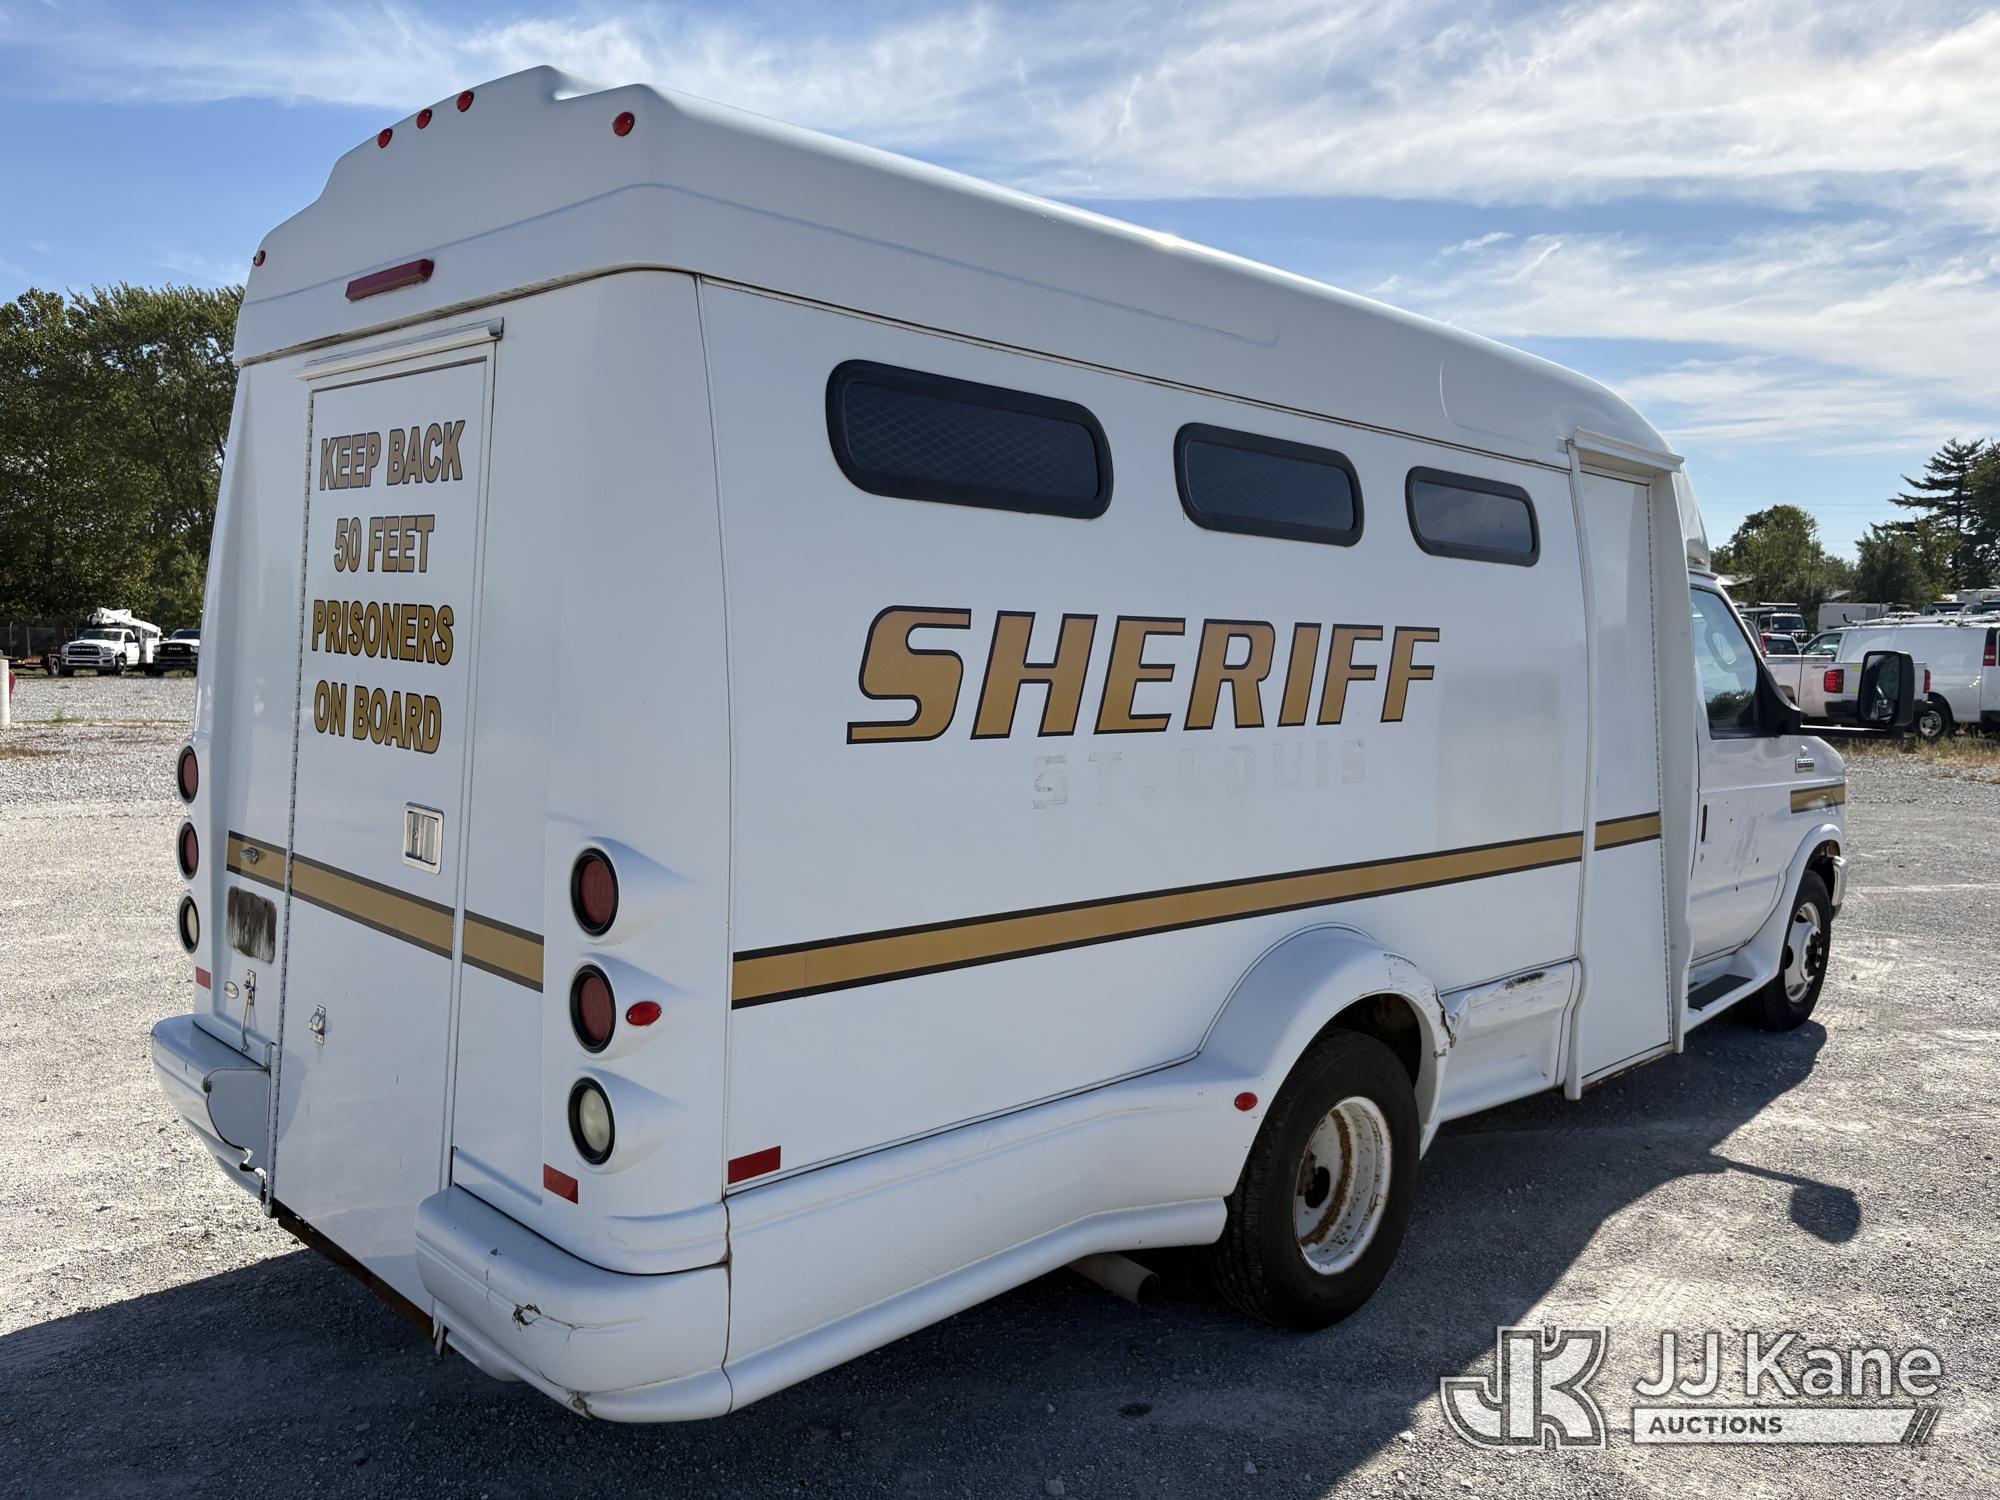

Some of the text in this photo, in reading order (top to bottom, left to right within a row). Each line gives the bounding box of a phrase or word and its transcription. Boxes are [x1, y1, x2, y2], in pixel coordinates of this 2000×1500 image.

[320, 420, 465, 490] KEEP BACK
[334, 514, 435, 573] 50 FEET
[311, 599, 454, 666] PRISONERS
[846, 605, 1441, 744] SHERIFF
[313, 679, 442, 754] ON BOARD
